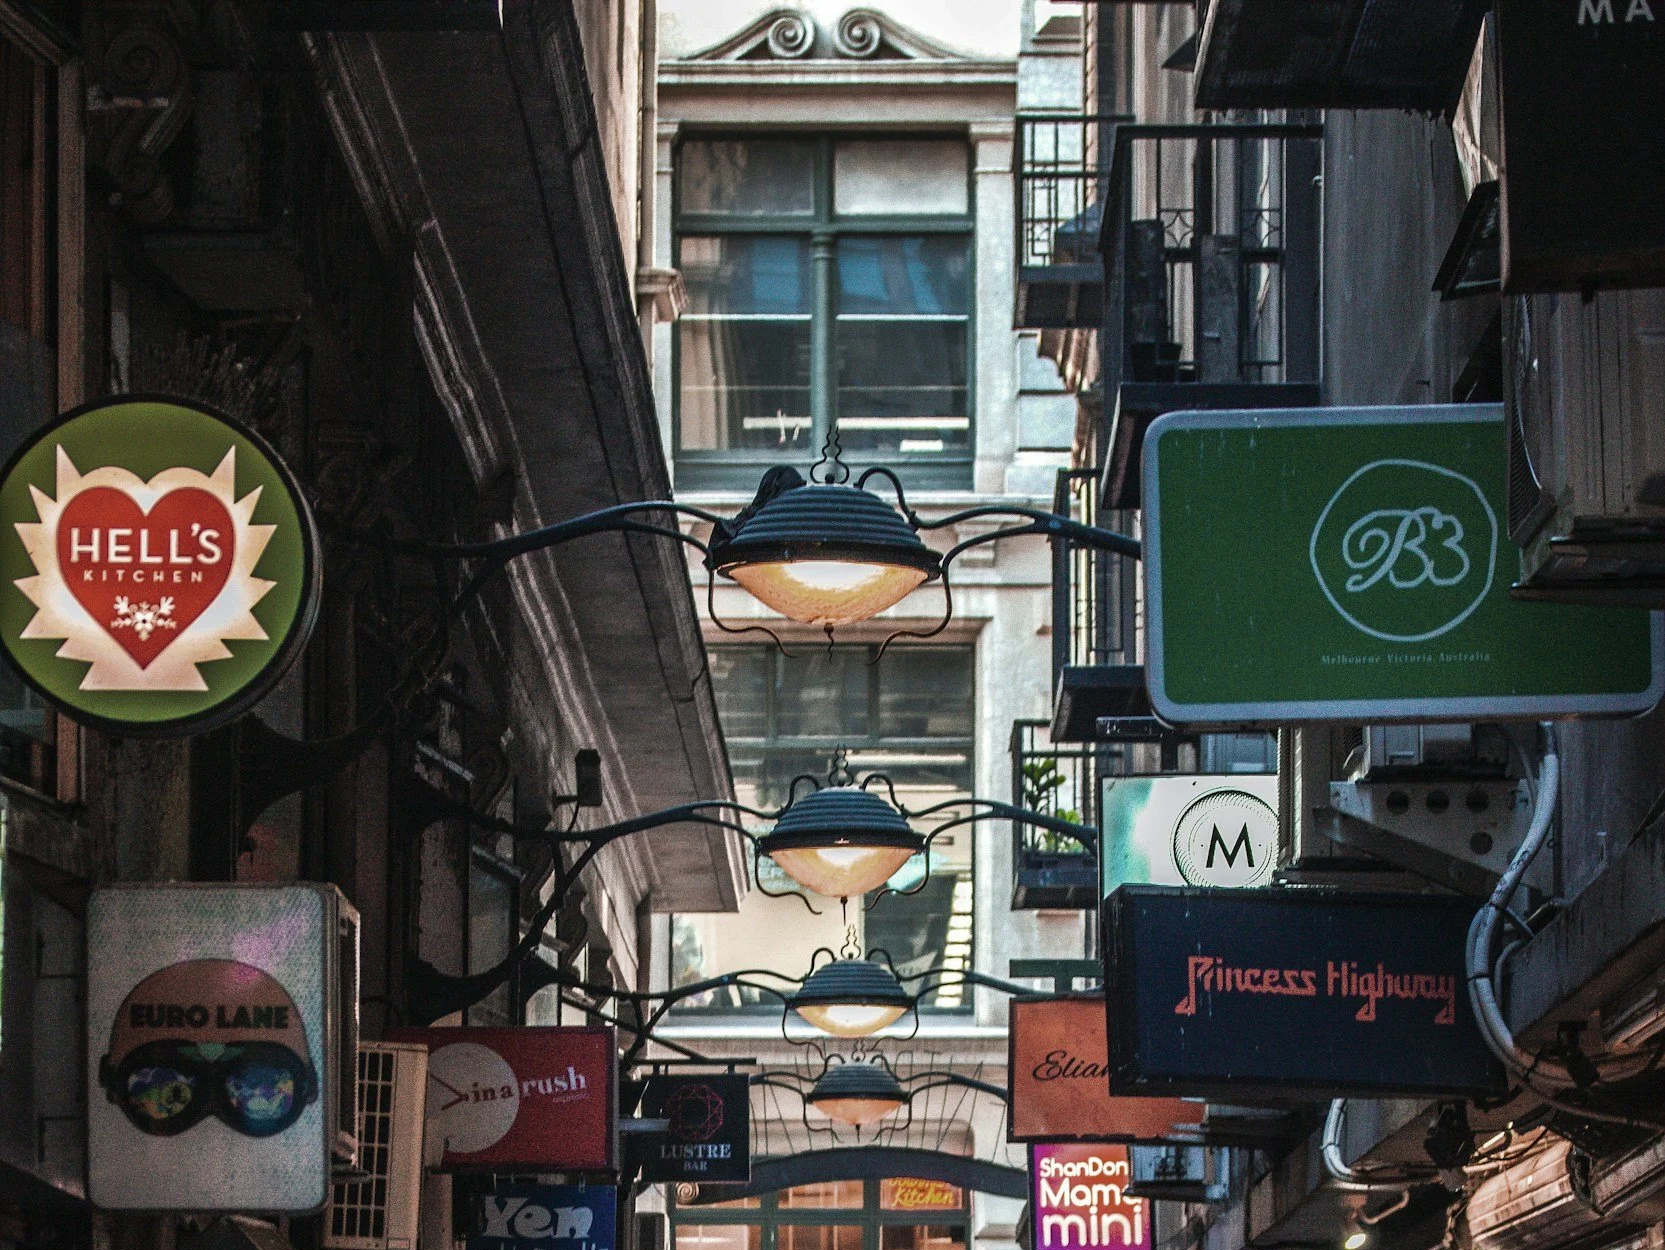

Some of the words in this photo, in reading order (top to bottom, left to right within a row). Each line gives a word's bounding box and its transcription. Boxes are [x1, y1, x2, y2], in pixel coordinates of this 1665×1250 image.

[70, 523, 222, 565] HELL'S
[83, 569, 203, 583] KITCHEN
[1438, 650, 1490, 662] Australia
[1205, 821, 1255, 869] M
[1174, 955, 1317, 1016] Princess
[1327, 960, 1455, 1025] Highway
[130, 1004, 209, 1028] EURO
[216, 1004, 289, 1028] LANE
[522, 1066, 586, 1097] rush
[660, 1144, 731, 1159] LUSTRE
[683, 1161, 708, 1171] BAR
[1040, 1157, 1129, 1177] ShanDon
[892, 1186, 953, 1207] Kitchen
[482, 1196, 593, 1239] Yen
[1042, 1206, 1142, 1246] mini
